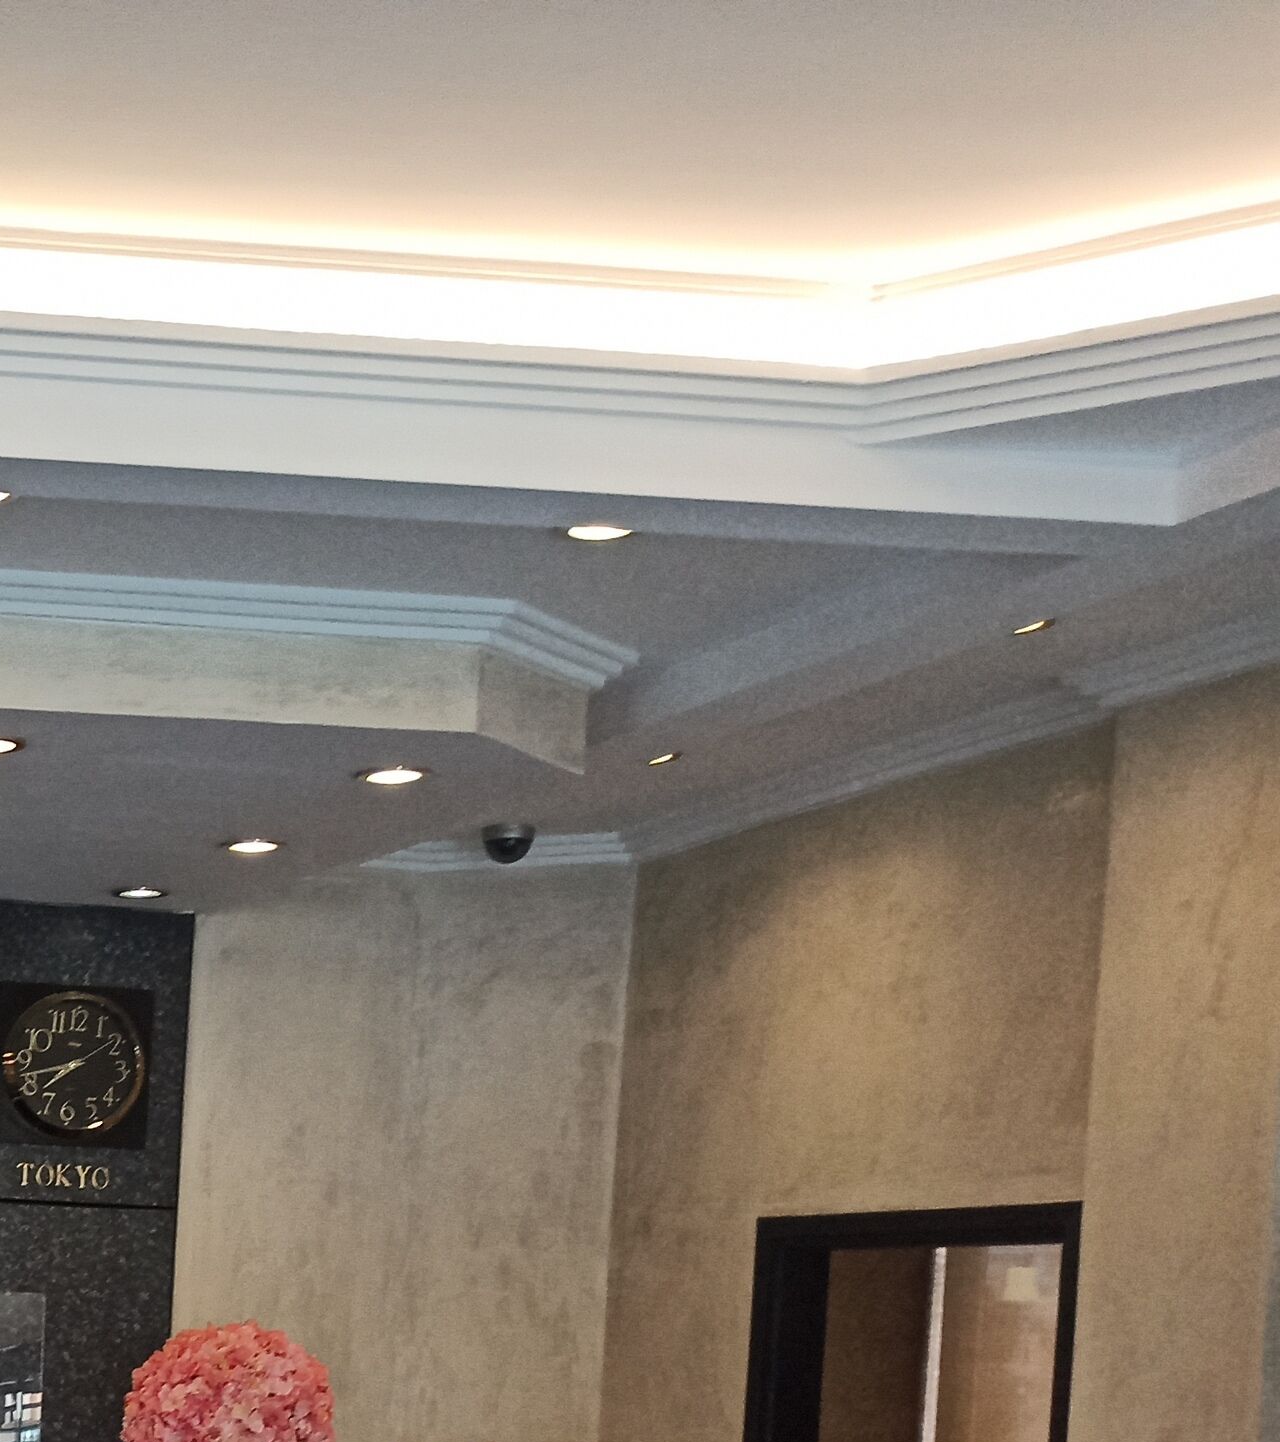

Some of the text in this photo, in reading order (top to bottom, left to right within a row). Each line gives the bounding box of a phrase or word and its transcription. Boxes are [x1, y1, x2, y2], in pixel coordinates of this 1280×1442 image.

[50, 1010, 65, 1033] 11
[70, 1008, 89, 1032] 12
[96, 1016, 104, 1038] 1
[29, 1028, 52, 1052] 10
[108, 1032, 122, 1056] 2
[16, 1049, 32, 1071] 9
[115, 1060, 130, 1083] 3
[22, 1072, 38, 1096] 8
[42, 1092, 56, 1115] 7
[85, 1097, 97, 1119] 5
[102, 1086, 114, 1107] 4
[60, 1100, 75, 1121] 6
[16, 1161, 110, 1190] TOKYO
